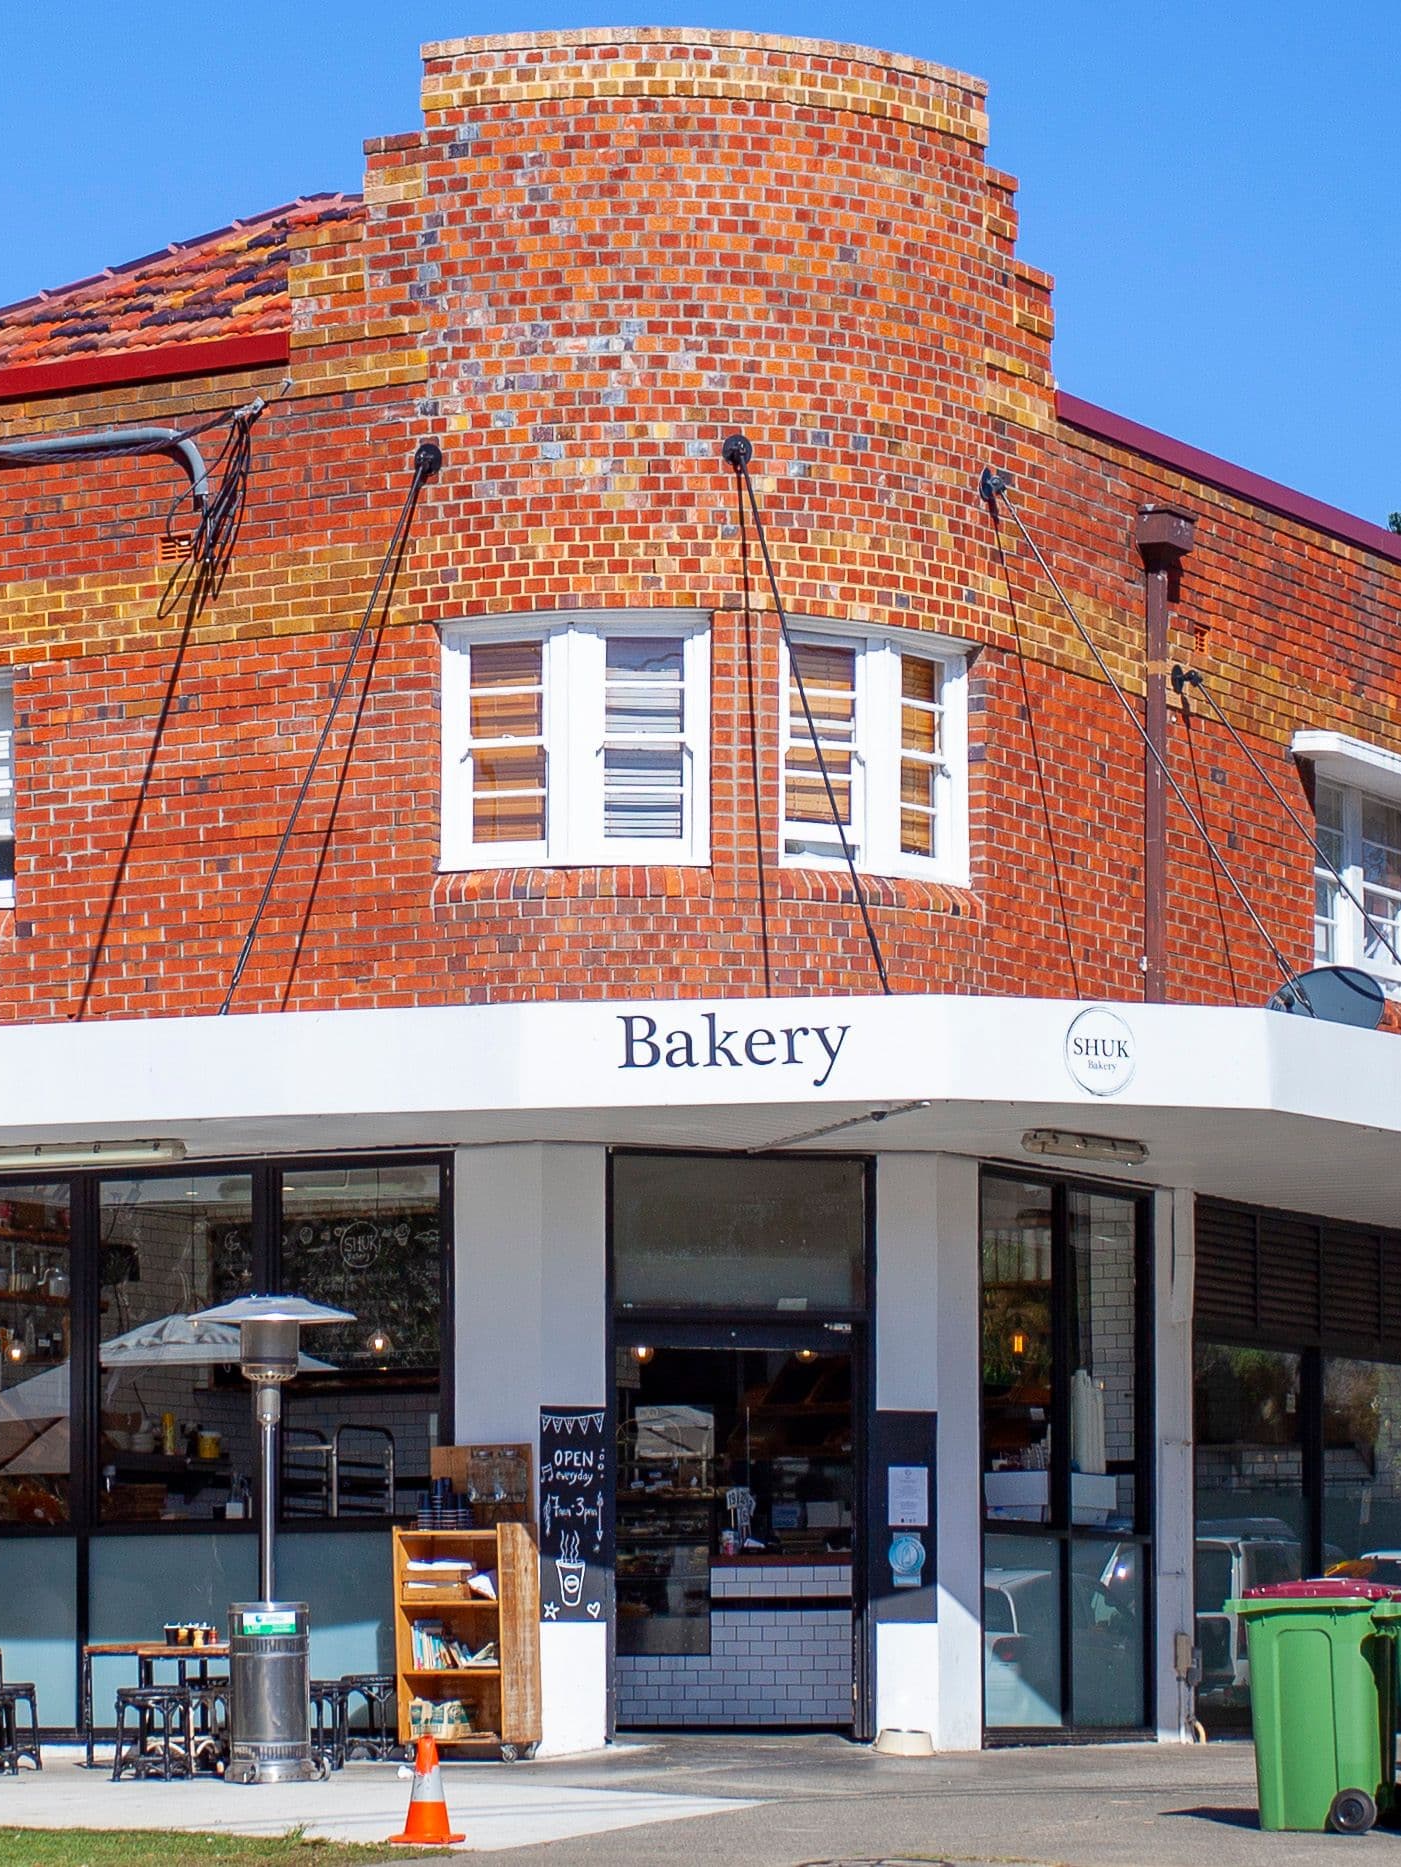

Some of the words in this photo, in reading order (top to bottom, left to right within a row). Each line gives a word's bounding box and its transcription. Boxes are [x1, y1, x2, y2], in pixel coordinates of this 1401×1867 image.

[616, 1012, 851, 1087] Bakery
[1073, 1037, 1129, 1058] SHUK
[1088, 1060, 1117, 1073] Bakery
[345, 1236, 377, 1252] SHUK
[554, 1450, 593, 1467] OPEN
[555, 1468, 593, 1488] everyday
